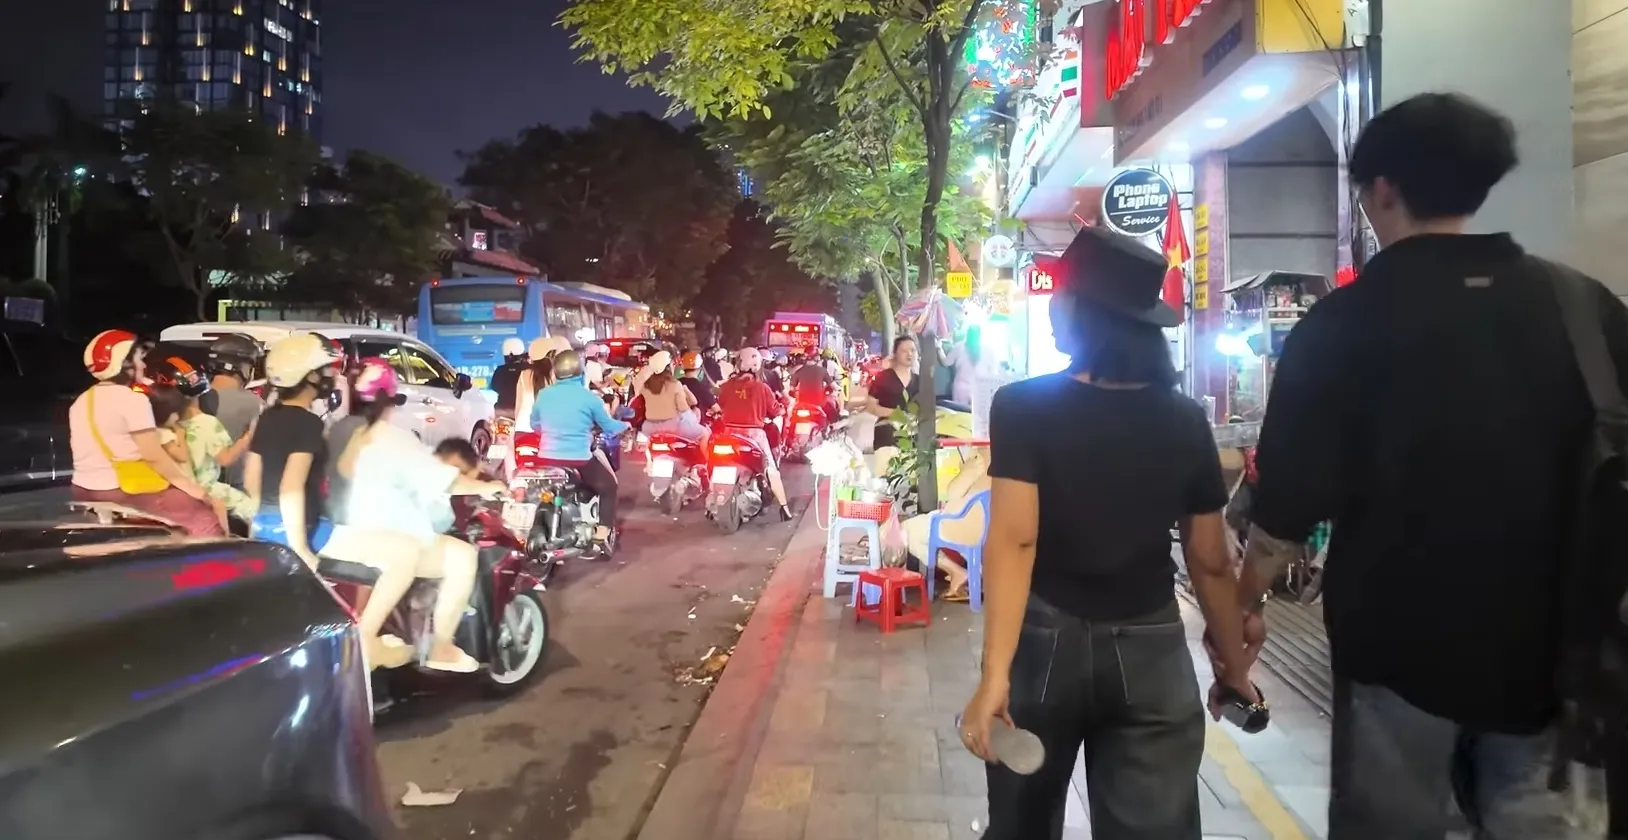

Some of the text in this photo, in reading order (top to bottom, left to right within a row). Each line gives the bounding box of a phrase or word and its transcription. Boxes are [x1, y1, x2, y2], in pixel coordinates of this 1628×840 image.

[1113, 183, 1160, 197] Phone
[1118, 194, 1168, 209] Laptop
[1122, 215, 1160, 226] Service
